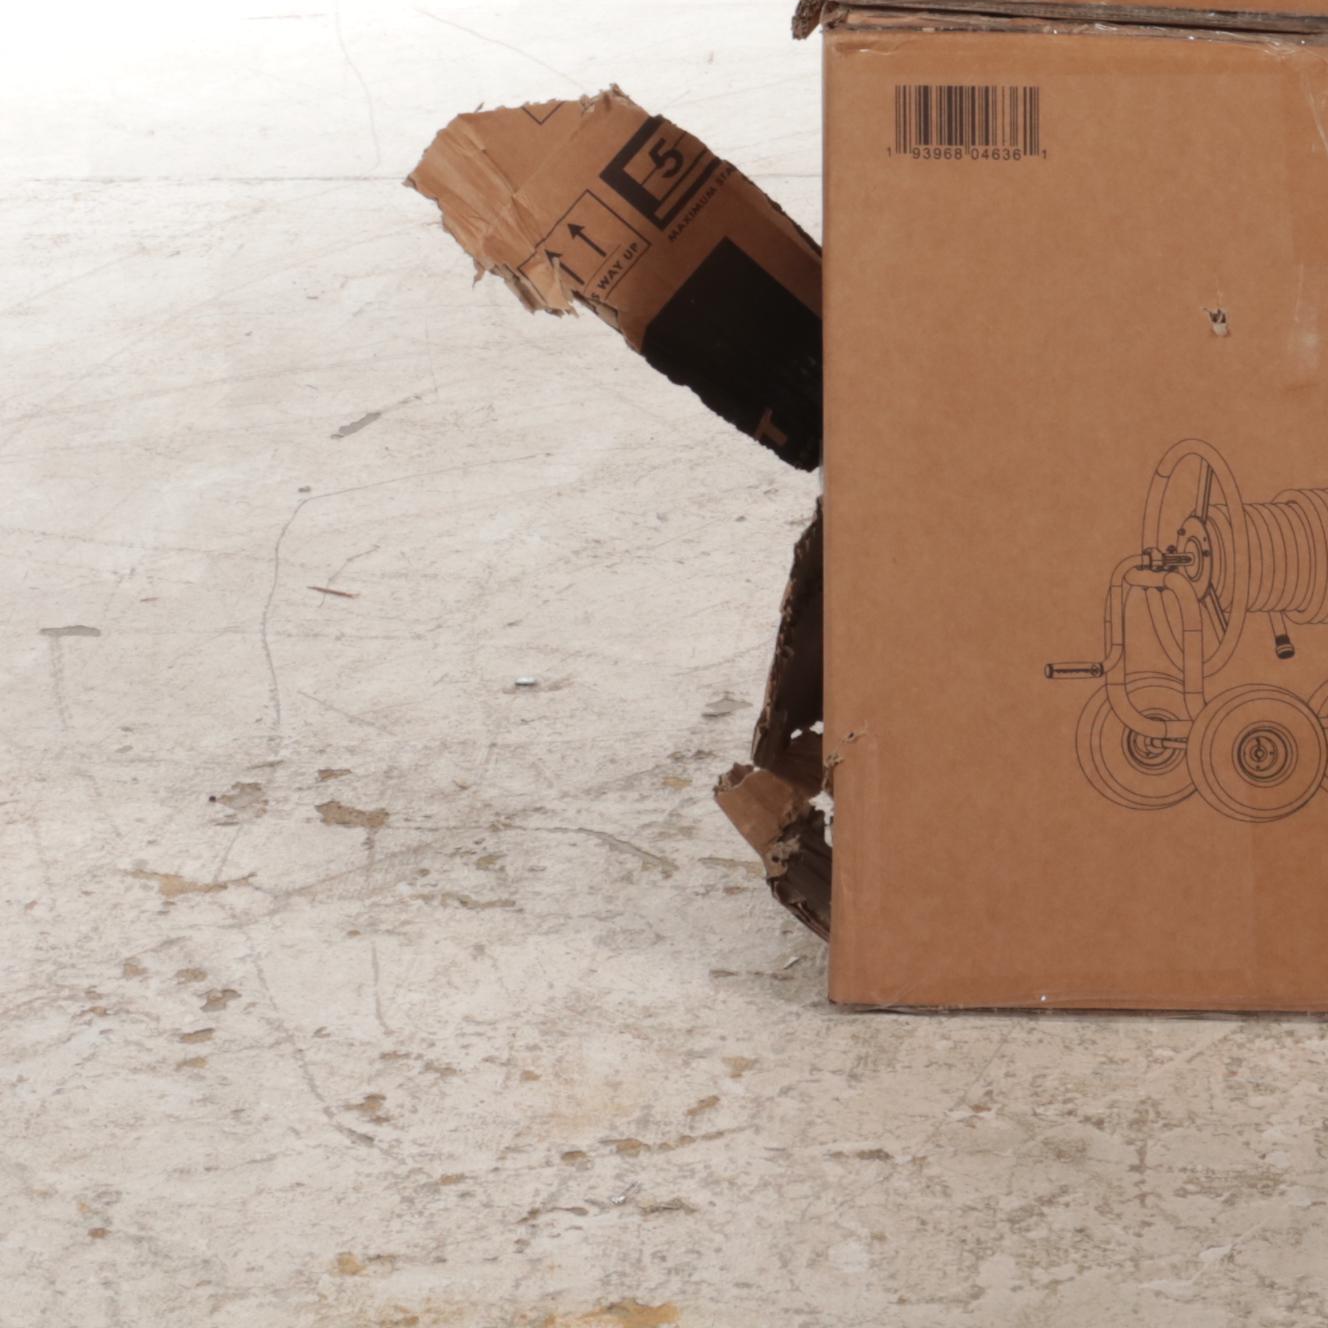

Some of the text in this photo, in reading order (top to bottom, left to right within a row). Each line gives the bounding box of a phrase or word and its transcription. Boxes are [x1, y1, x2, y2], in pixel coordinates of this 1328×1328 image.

[650, 138, 685, 179] 5
[911, 147, 963, 160] 93968
[970, 147, 1022, 161] 04636
[668, 187, 717, 242] MAXIMUM
[598, 260, 624, 291] WAY
